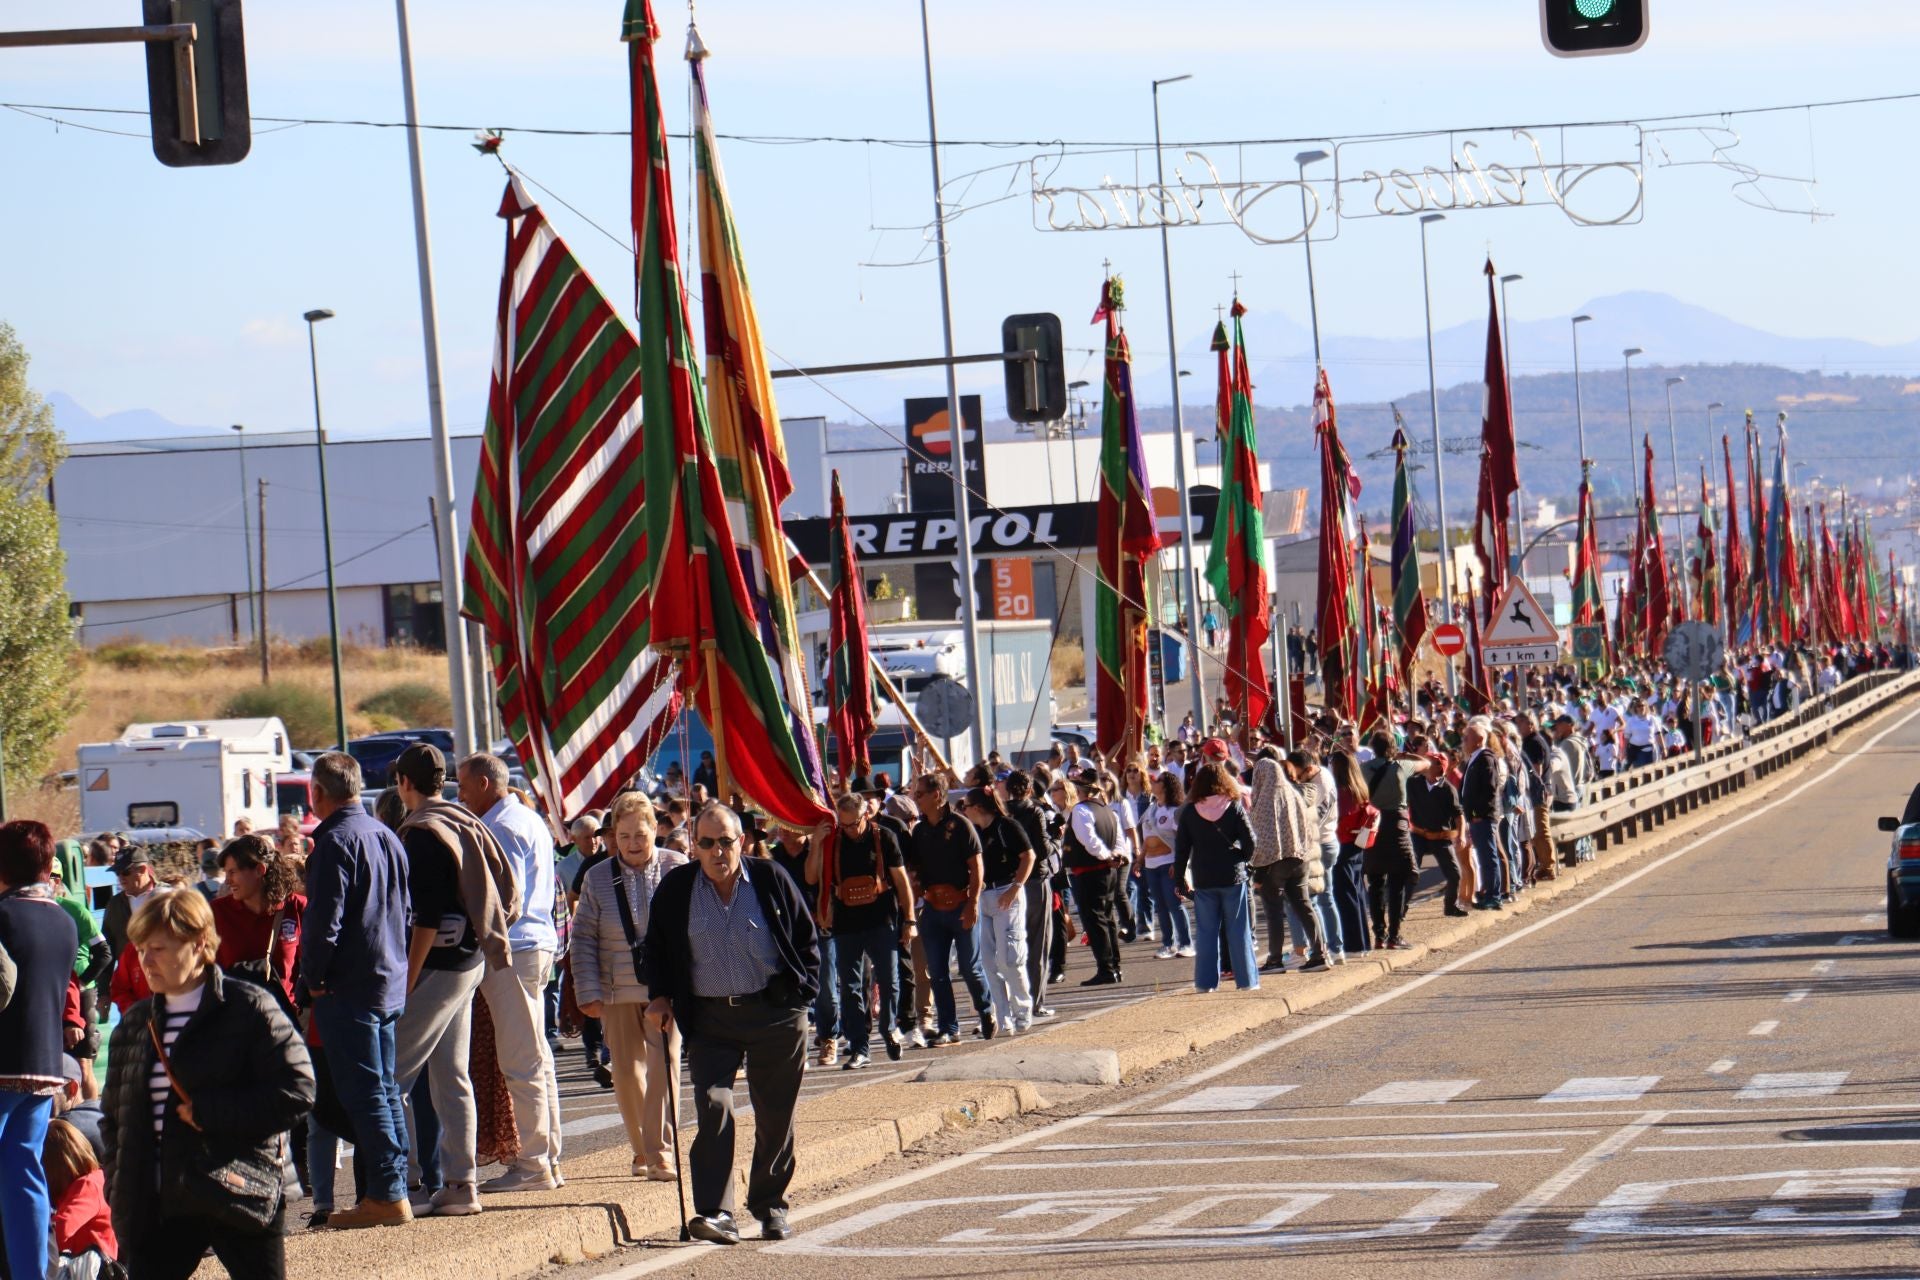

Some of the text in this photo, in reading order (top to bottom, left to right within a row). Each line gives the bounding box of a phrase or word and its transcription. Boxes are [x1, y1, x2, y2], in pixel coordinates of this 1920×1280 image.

[850, 512, 1058, 554] REPSOL
[997, 567, 1011, 588] 5
[998, 595, 1029, 616] 20
[1506, 651, 1535, 661] 1 km
